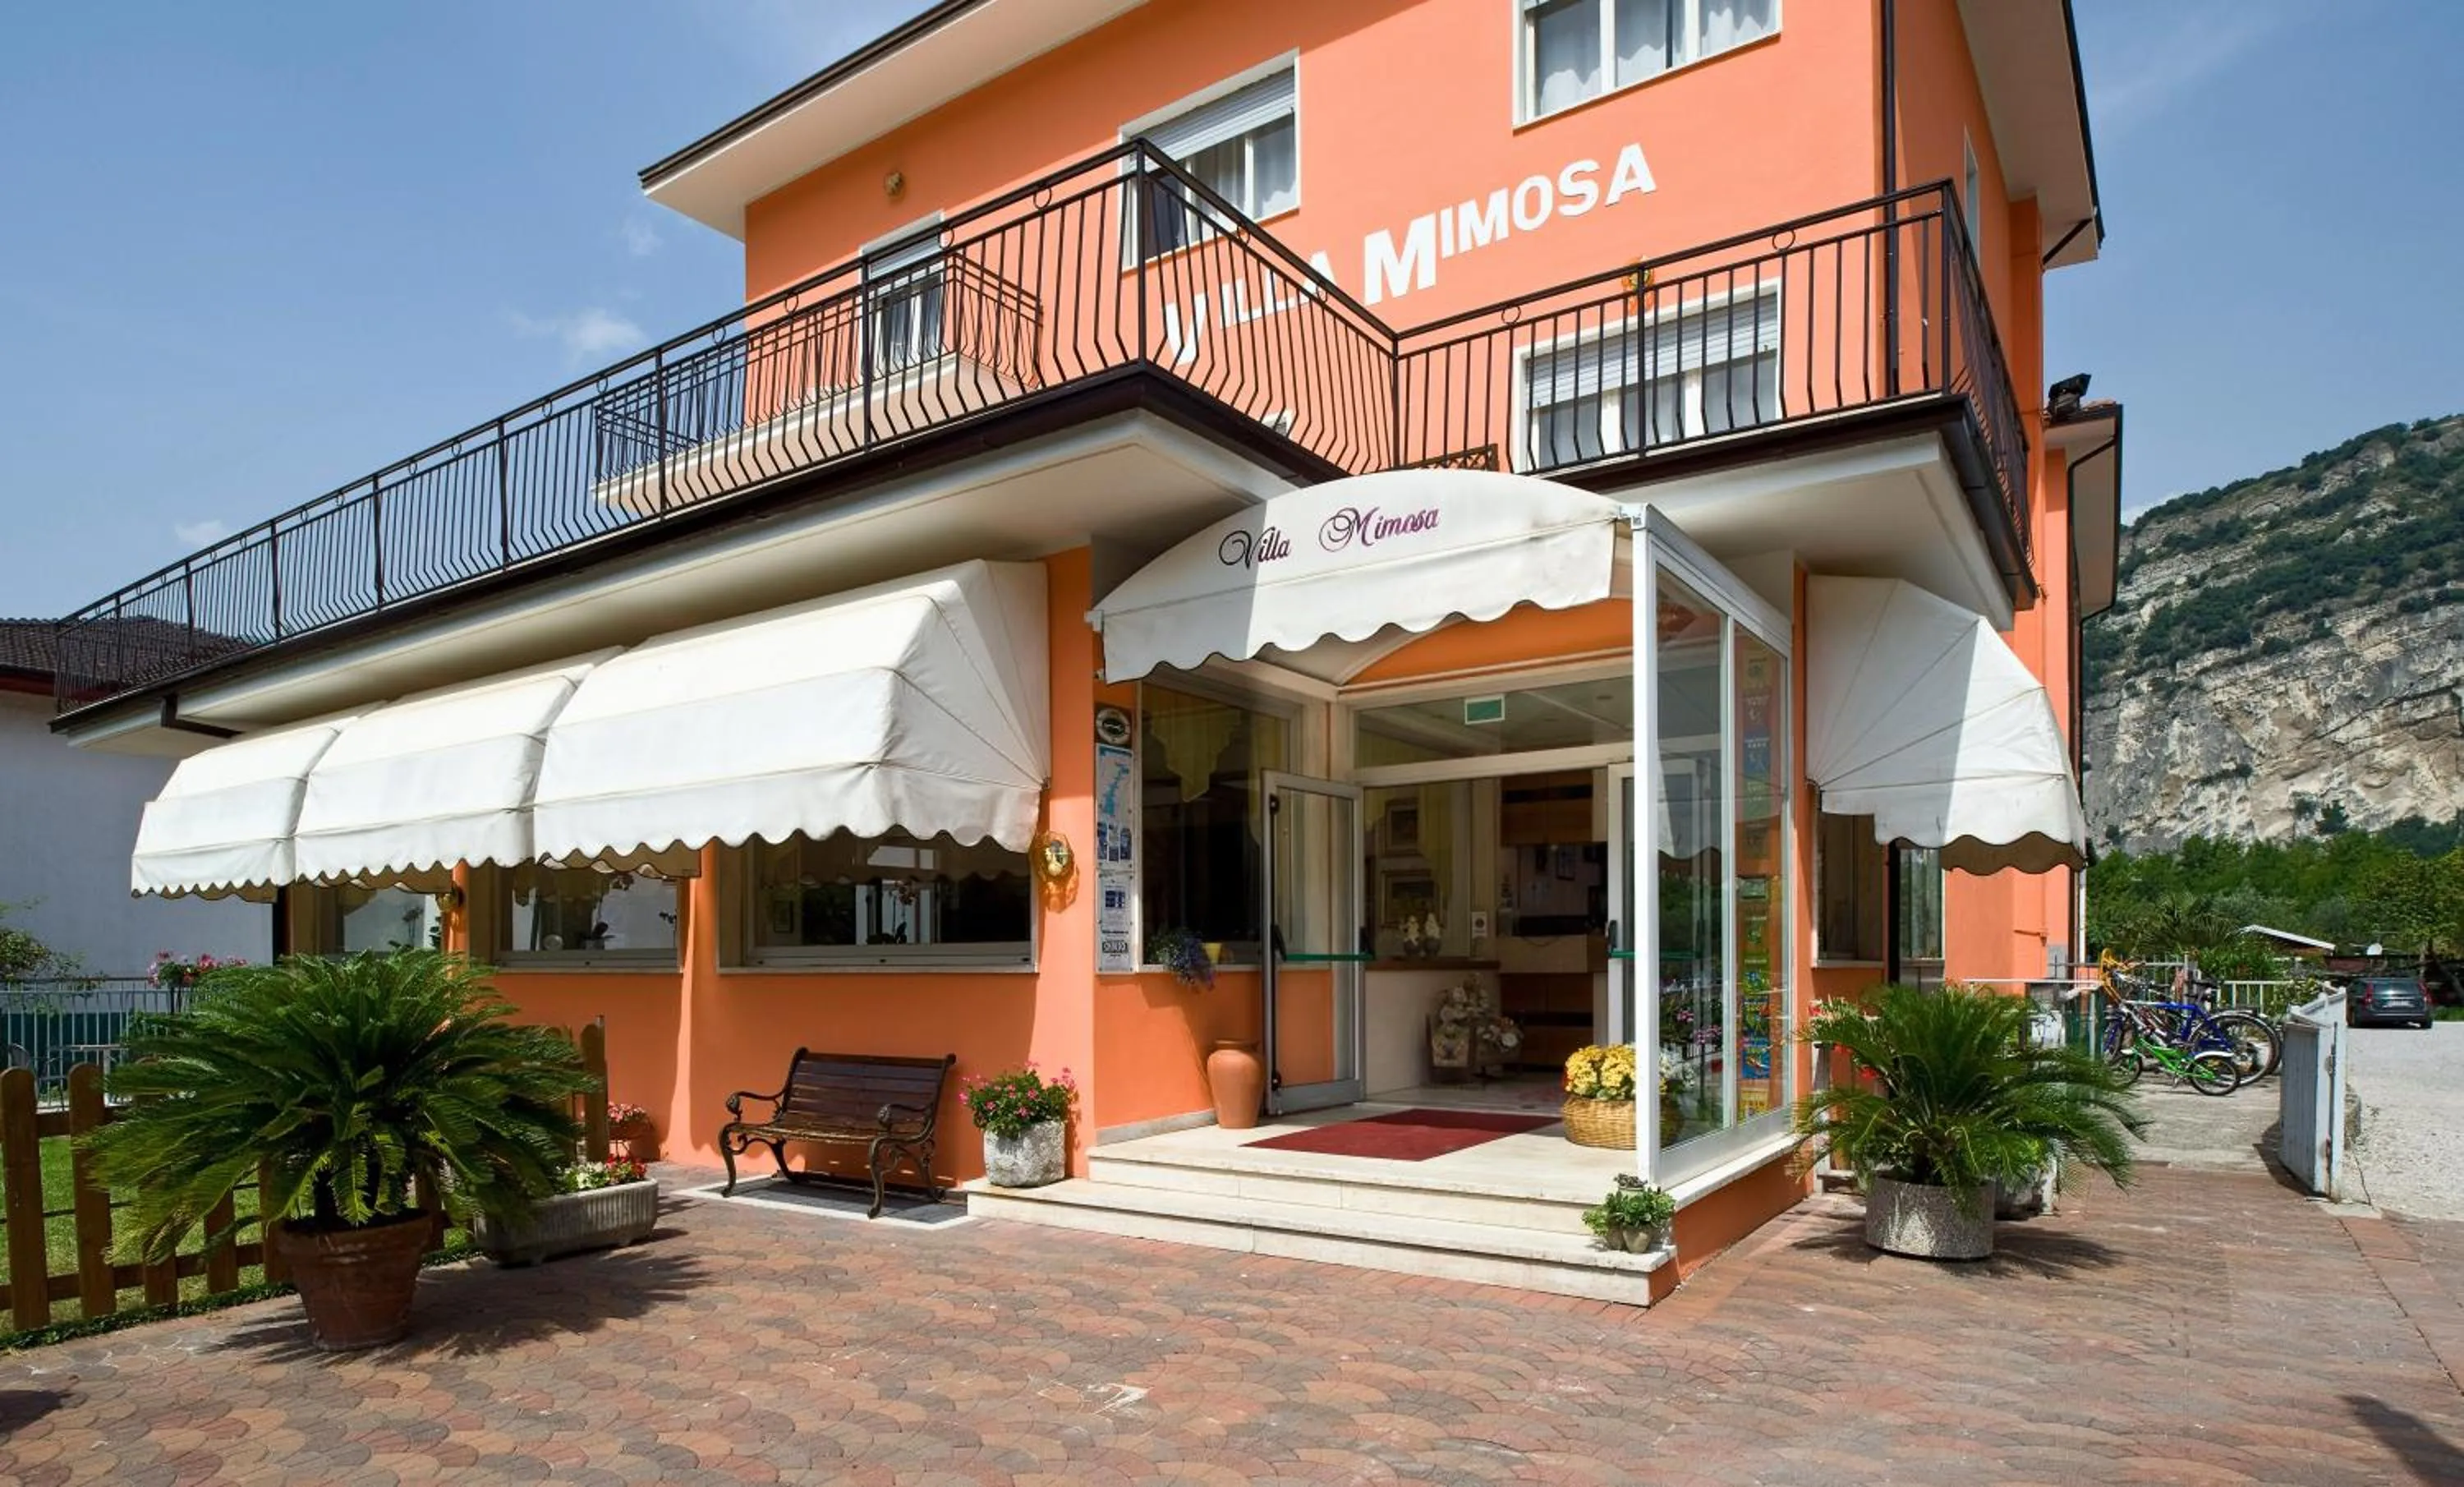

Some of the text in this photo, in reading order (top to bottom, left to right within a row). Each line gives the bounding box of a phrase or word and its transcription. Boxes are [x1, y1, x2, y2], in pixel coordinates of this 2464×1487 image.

[1363, 142, 1657, 307] MIMOSA
[1218, 506, 1441, 570] Villa Mimosa
